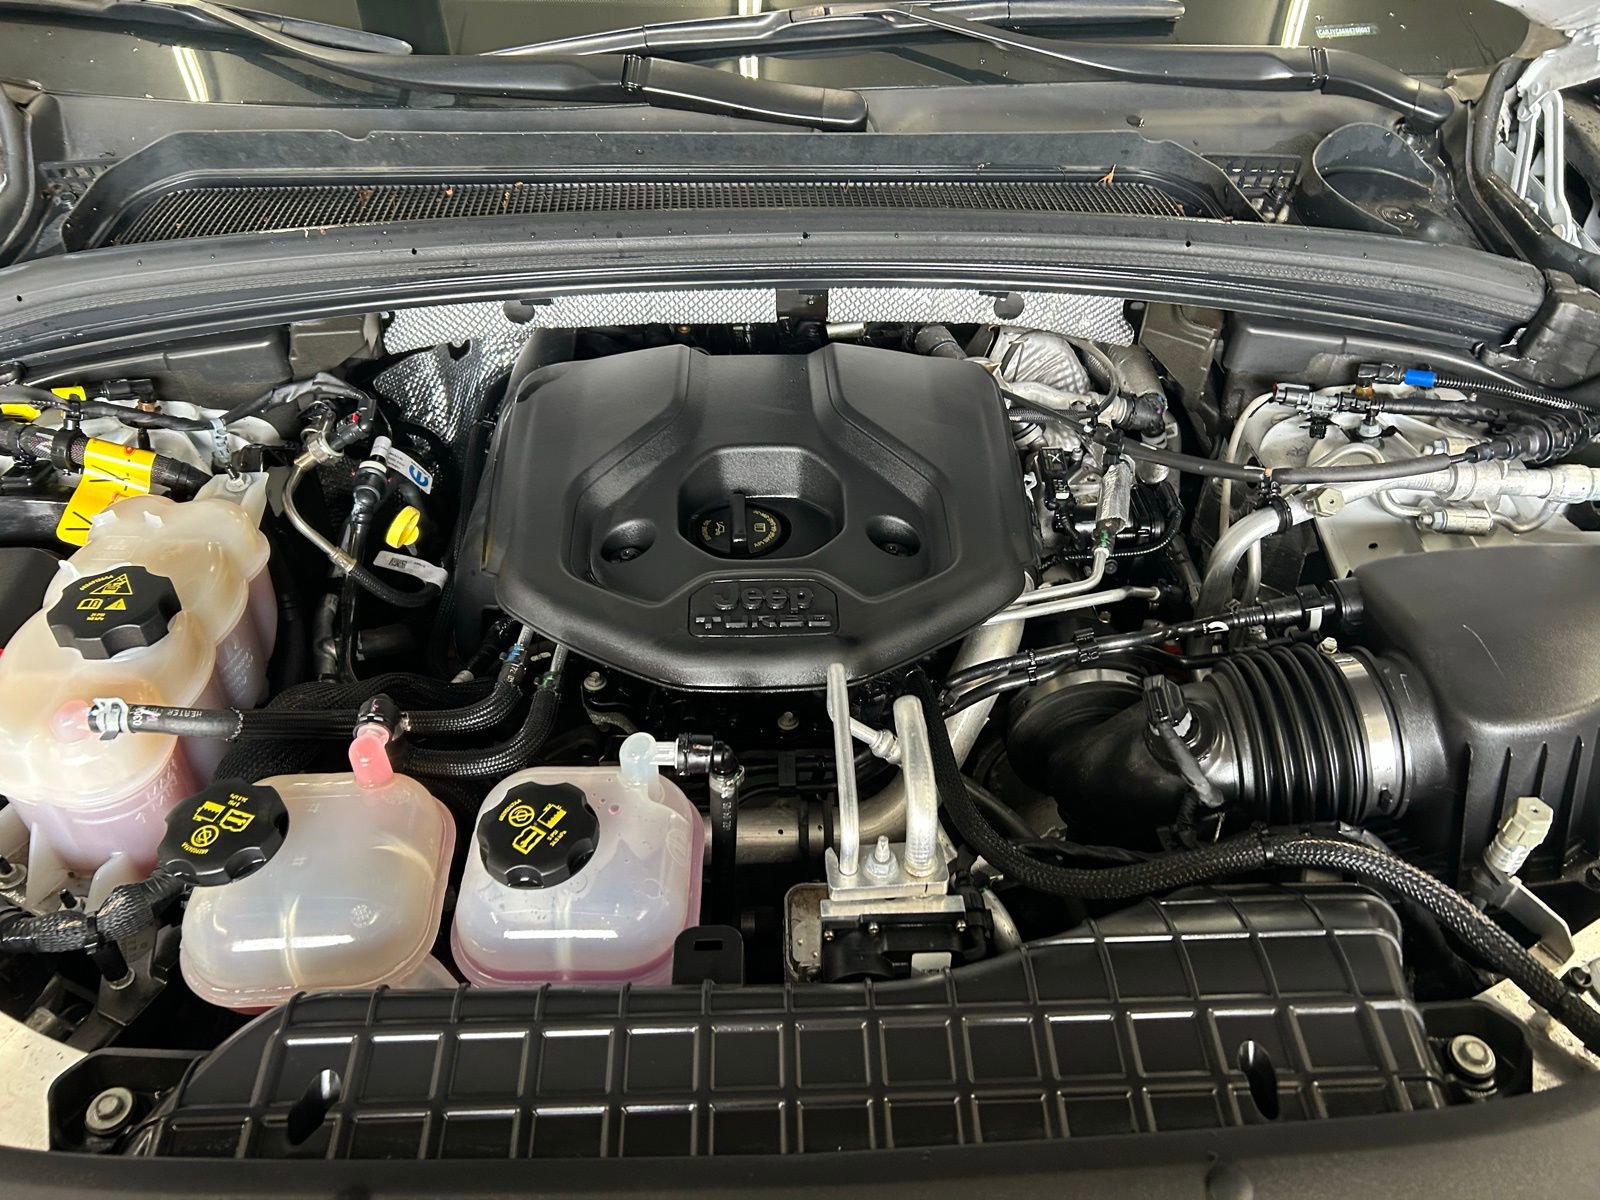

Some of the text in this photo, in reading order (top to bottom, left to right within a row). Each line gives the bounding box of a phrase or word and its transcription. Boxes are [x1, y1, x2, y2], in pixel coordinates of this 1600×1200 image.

[713, 583, 813, 613] Jeep
[695, 615, 832, 629] TURBO
[167, 709, 202, 718] HEATER
